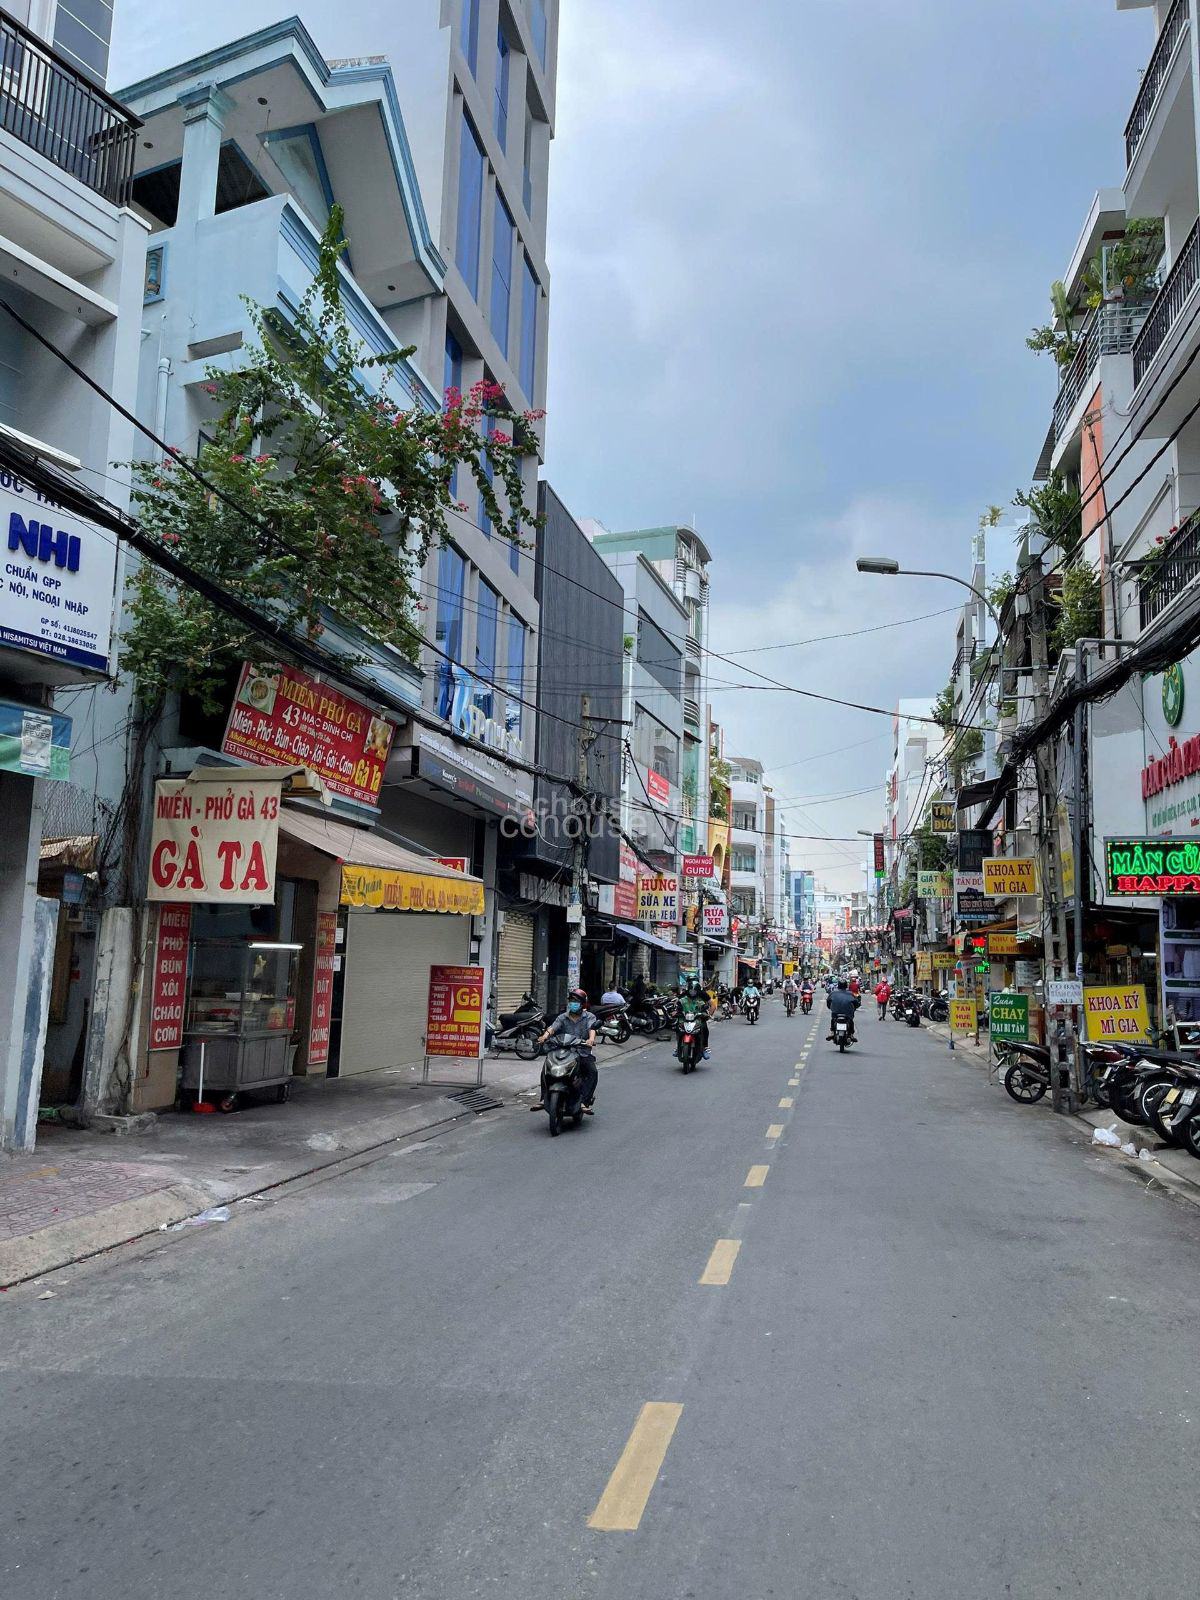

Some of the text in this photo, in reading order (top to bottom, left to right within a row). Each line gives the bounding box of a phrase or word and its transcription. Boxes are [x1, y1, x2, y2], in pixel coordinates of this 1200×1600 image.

[8, 512, 81, 574] NHI
[6, 563, 62, 590] CHUẨN GPP
[32, 589, 60, 608] NGOẠI
[65, 600, 89, 616] NHẬP
[41, 617, 50, 625] GP
[3, 631, 67, 656] HISAMITSU VIỆT NAM
[280, 677, 318, 710] MIẾN
[347, 711, 365, 734] GÀ
[282, 705, 300, 727] 43
[341, 730, 353, 743] CHI
[232, 709, 253, 735] Miến
[274, 728, 290, 750] Bún
[292, 735, 310, 758] Cháo
[339, 755, 353, 775] Cơm
[355, 758, 370, 788] Gà
[370, 764, 382, 792] Ta
[157, 787, 192, 819] MIẾN
[205, 787, 235, 820] PHỞ
[237, 791, 255, 820] GÀ
[260, 797, 278, 820] 43
[934, 818, 955, 830] ĐỨC
[152, 826, 269, 891] GÀ TA
[1112, 846, 1163, 875] MÀN
[686, 867, 711, 875] GURU
[987, 864, 1016, 877] KHOA
[641, 875, 677, 892] HÙNG
[994, 879, 1028, 893] MÌ GIA
[641, 893, 676, 907] SỬA XE
[638, 910, 649, 919] TAY
[661, 910, 668, 920] XE
[704, 906, 725, 917] RỬA
[707, 918, 721, 926] XE
[161, 957, 182, 974] BÚN
[161, 979, 179, 997] XÔI
[456, 987, 481, 1007] Gà
[993, 996, 1014, 1005] Quán
[1088, 996, 1121, 1011] KHOA
[154, 1002, 182, 1020] CHÁO
[992, 1007, 1026, 1020] CHAY
[1101, 1016, 1139, 1034] MÌ GIA
[155, 1026, 178, 1043] CƠM
